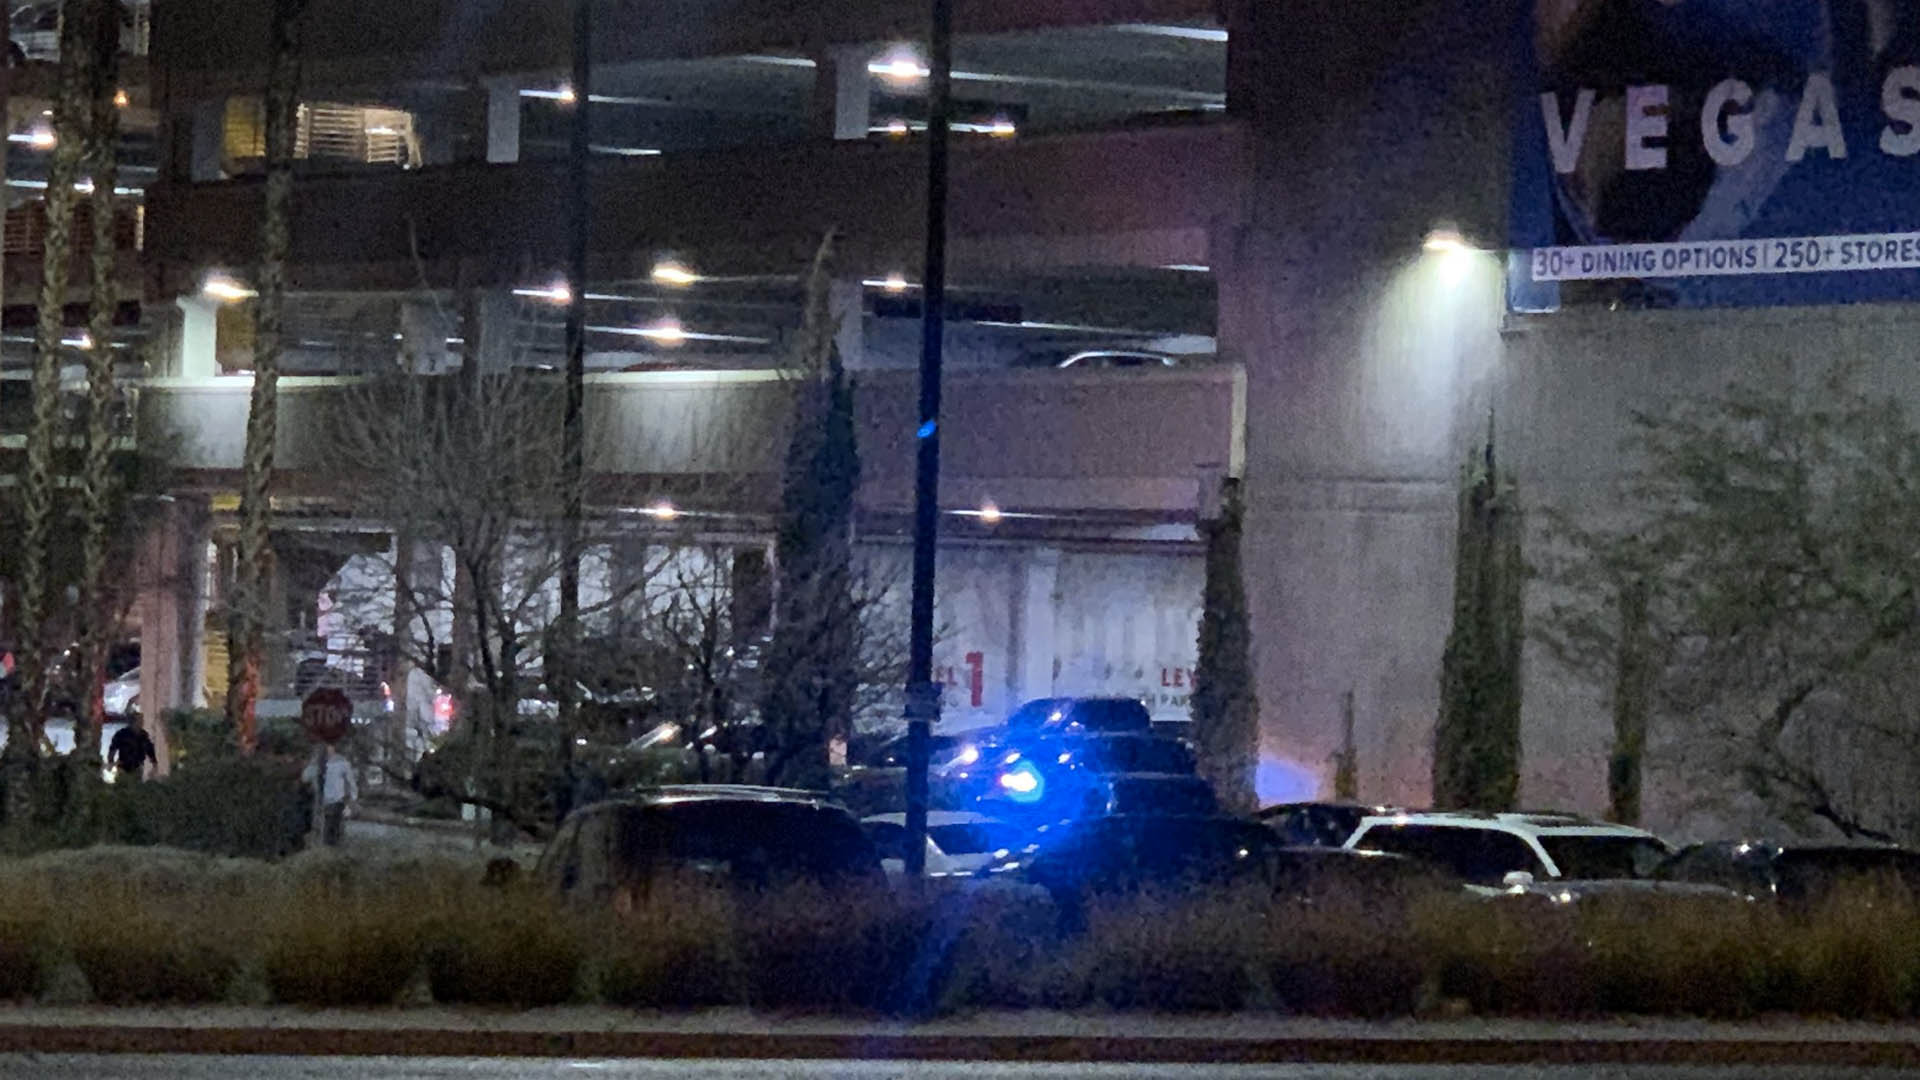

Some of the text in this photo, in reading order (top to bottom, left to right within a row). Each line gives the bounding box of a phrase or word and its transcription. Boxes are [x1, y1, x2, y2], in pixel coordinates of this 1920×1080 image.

[1539, 64, 1920, 174] VEGAS
[1535, 251, 1575, 277] 30+
[1581, 250, 1657, 274] DINING
[1661, 244, 1757, 270] OPTIONS
[1774, 240, 1835, 268] 250+
[965, 651, 984, 708] 1
